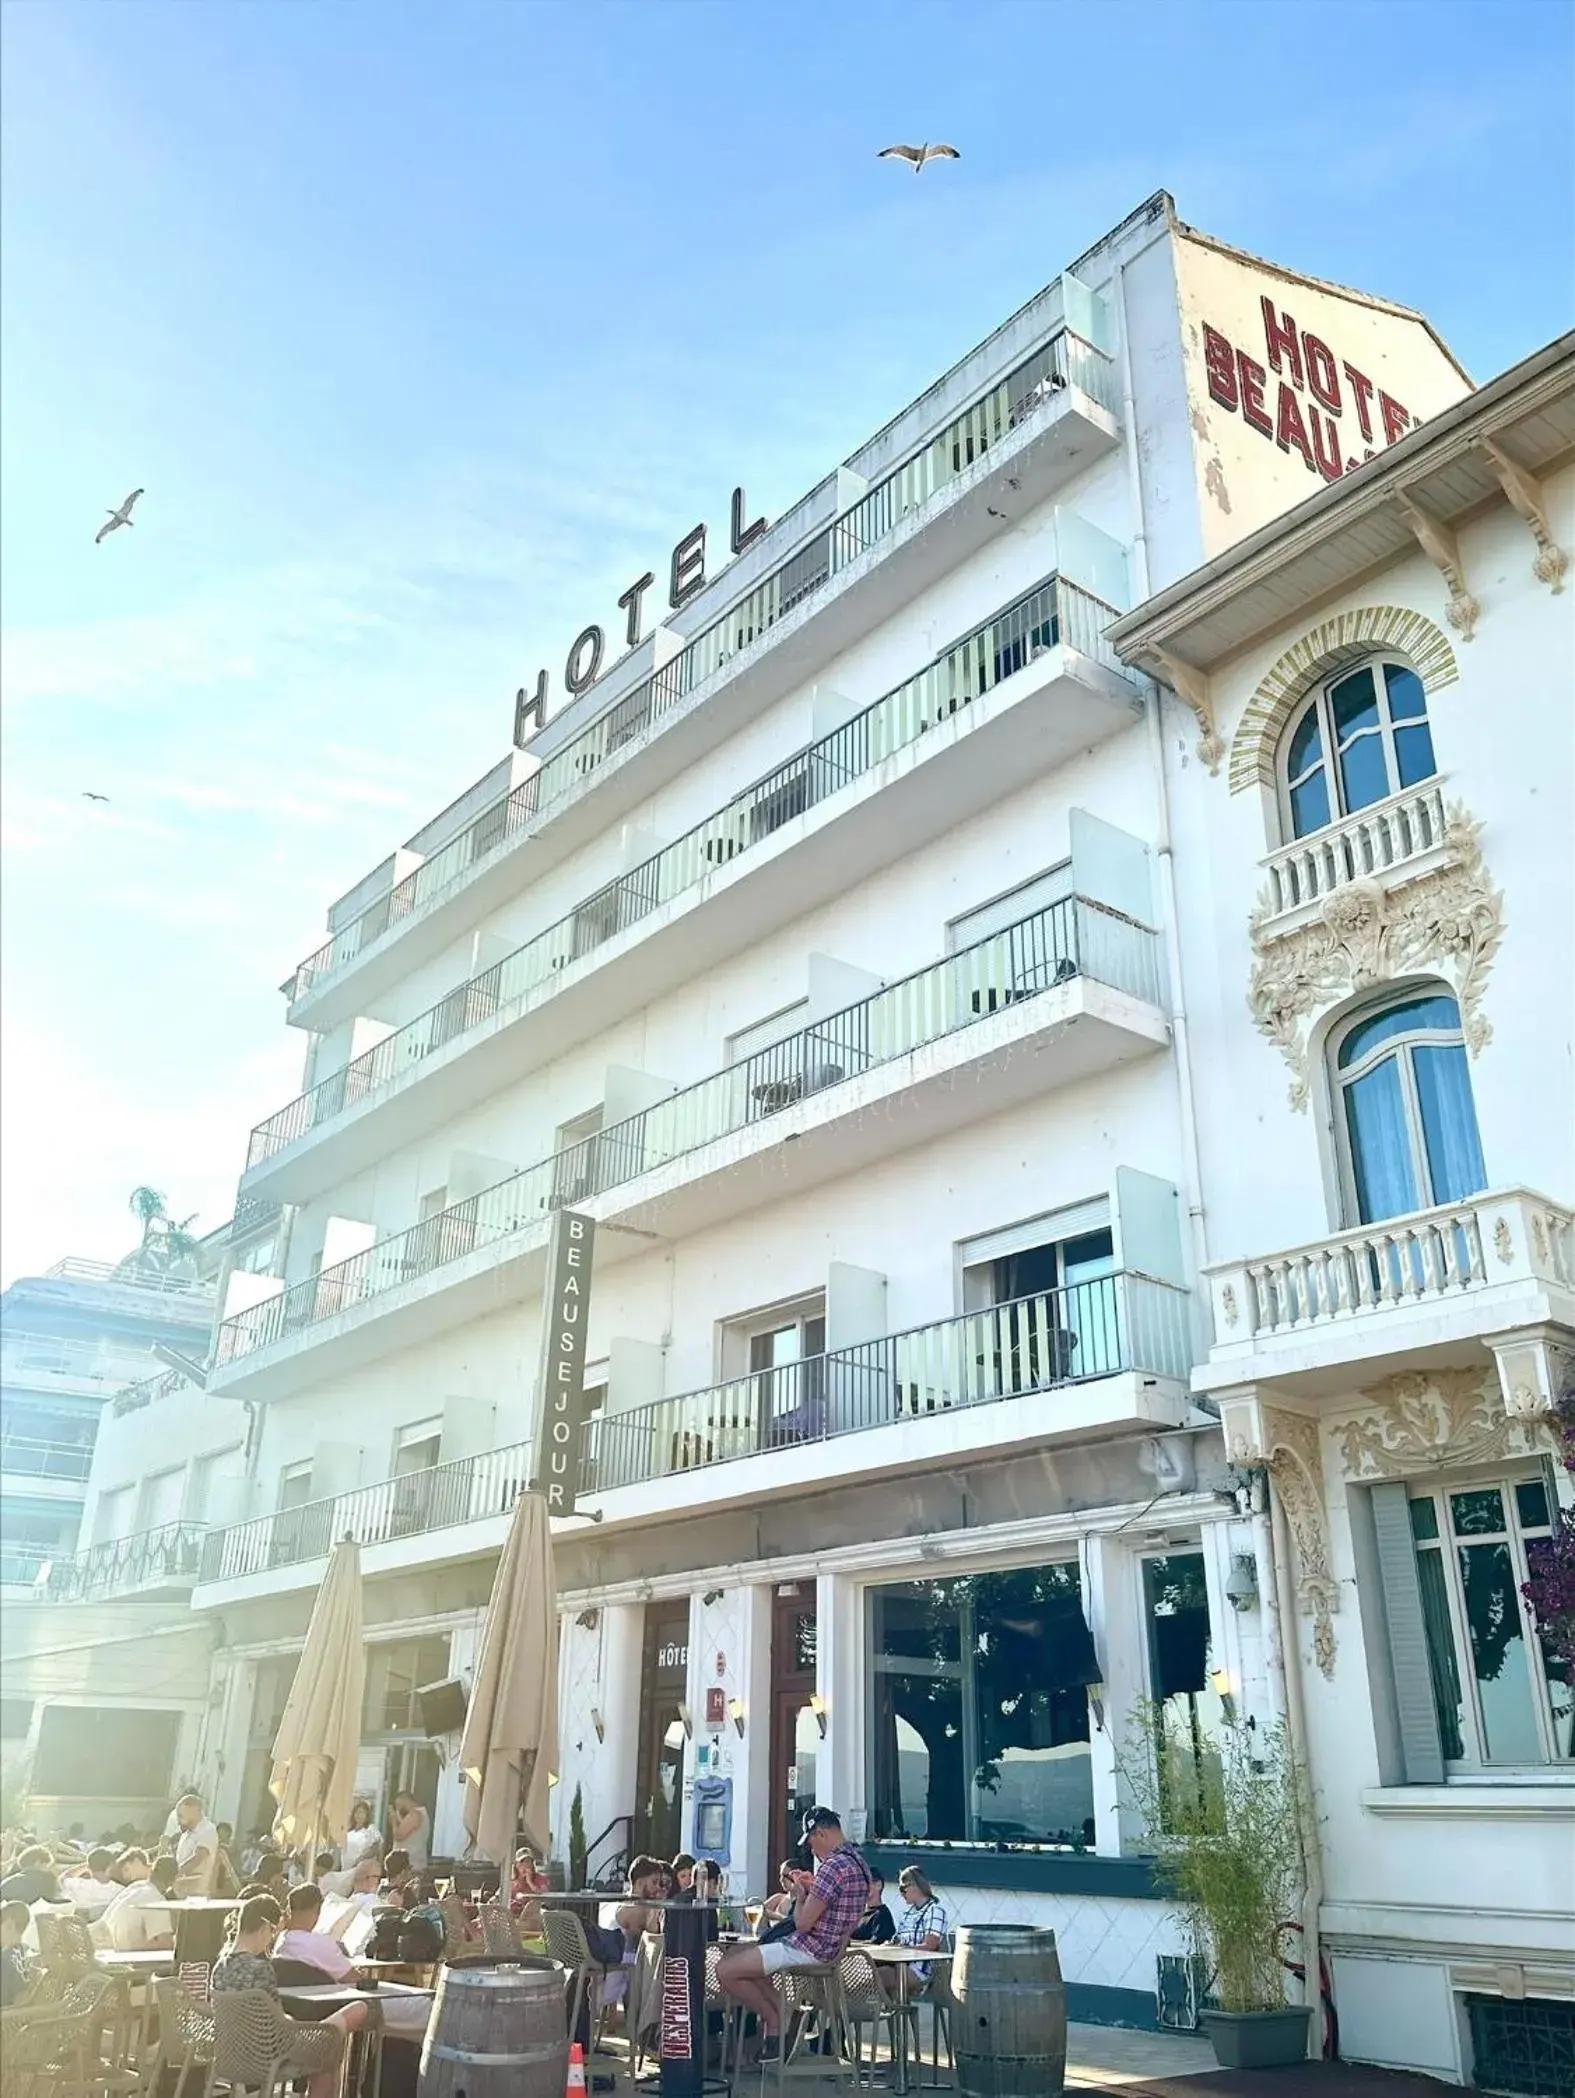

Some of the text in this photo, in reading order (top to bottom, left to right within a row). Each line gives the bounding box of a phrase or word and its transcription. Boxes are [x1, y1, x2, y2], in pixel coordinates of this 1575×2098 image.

[1260, 295, 1423, 448] HOTE
[513, 486, 769, 747] HOTEL
[548, 1220, 584, 1507] BEAUSEJOUR
[658, 1642, 688, 1667] HÔTE
[662, 1956, 691, 2059] DESPERADOS
